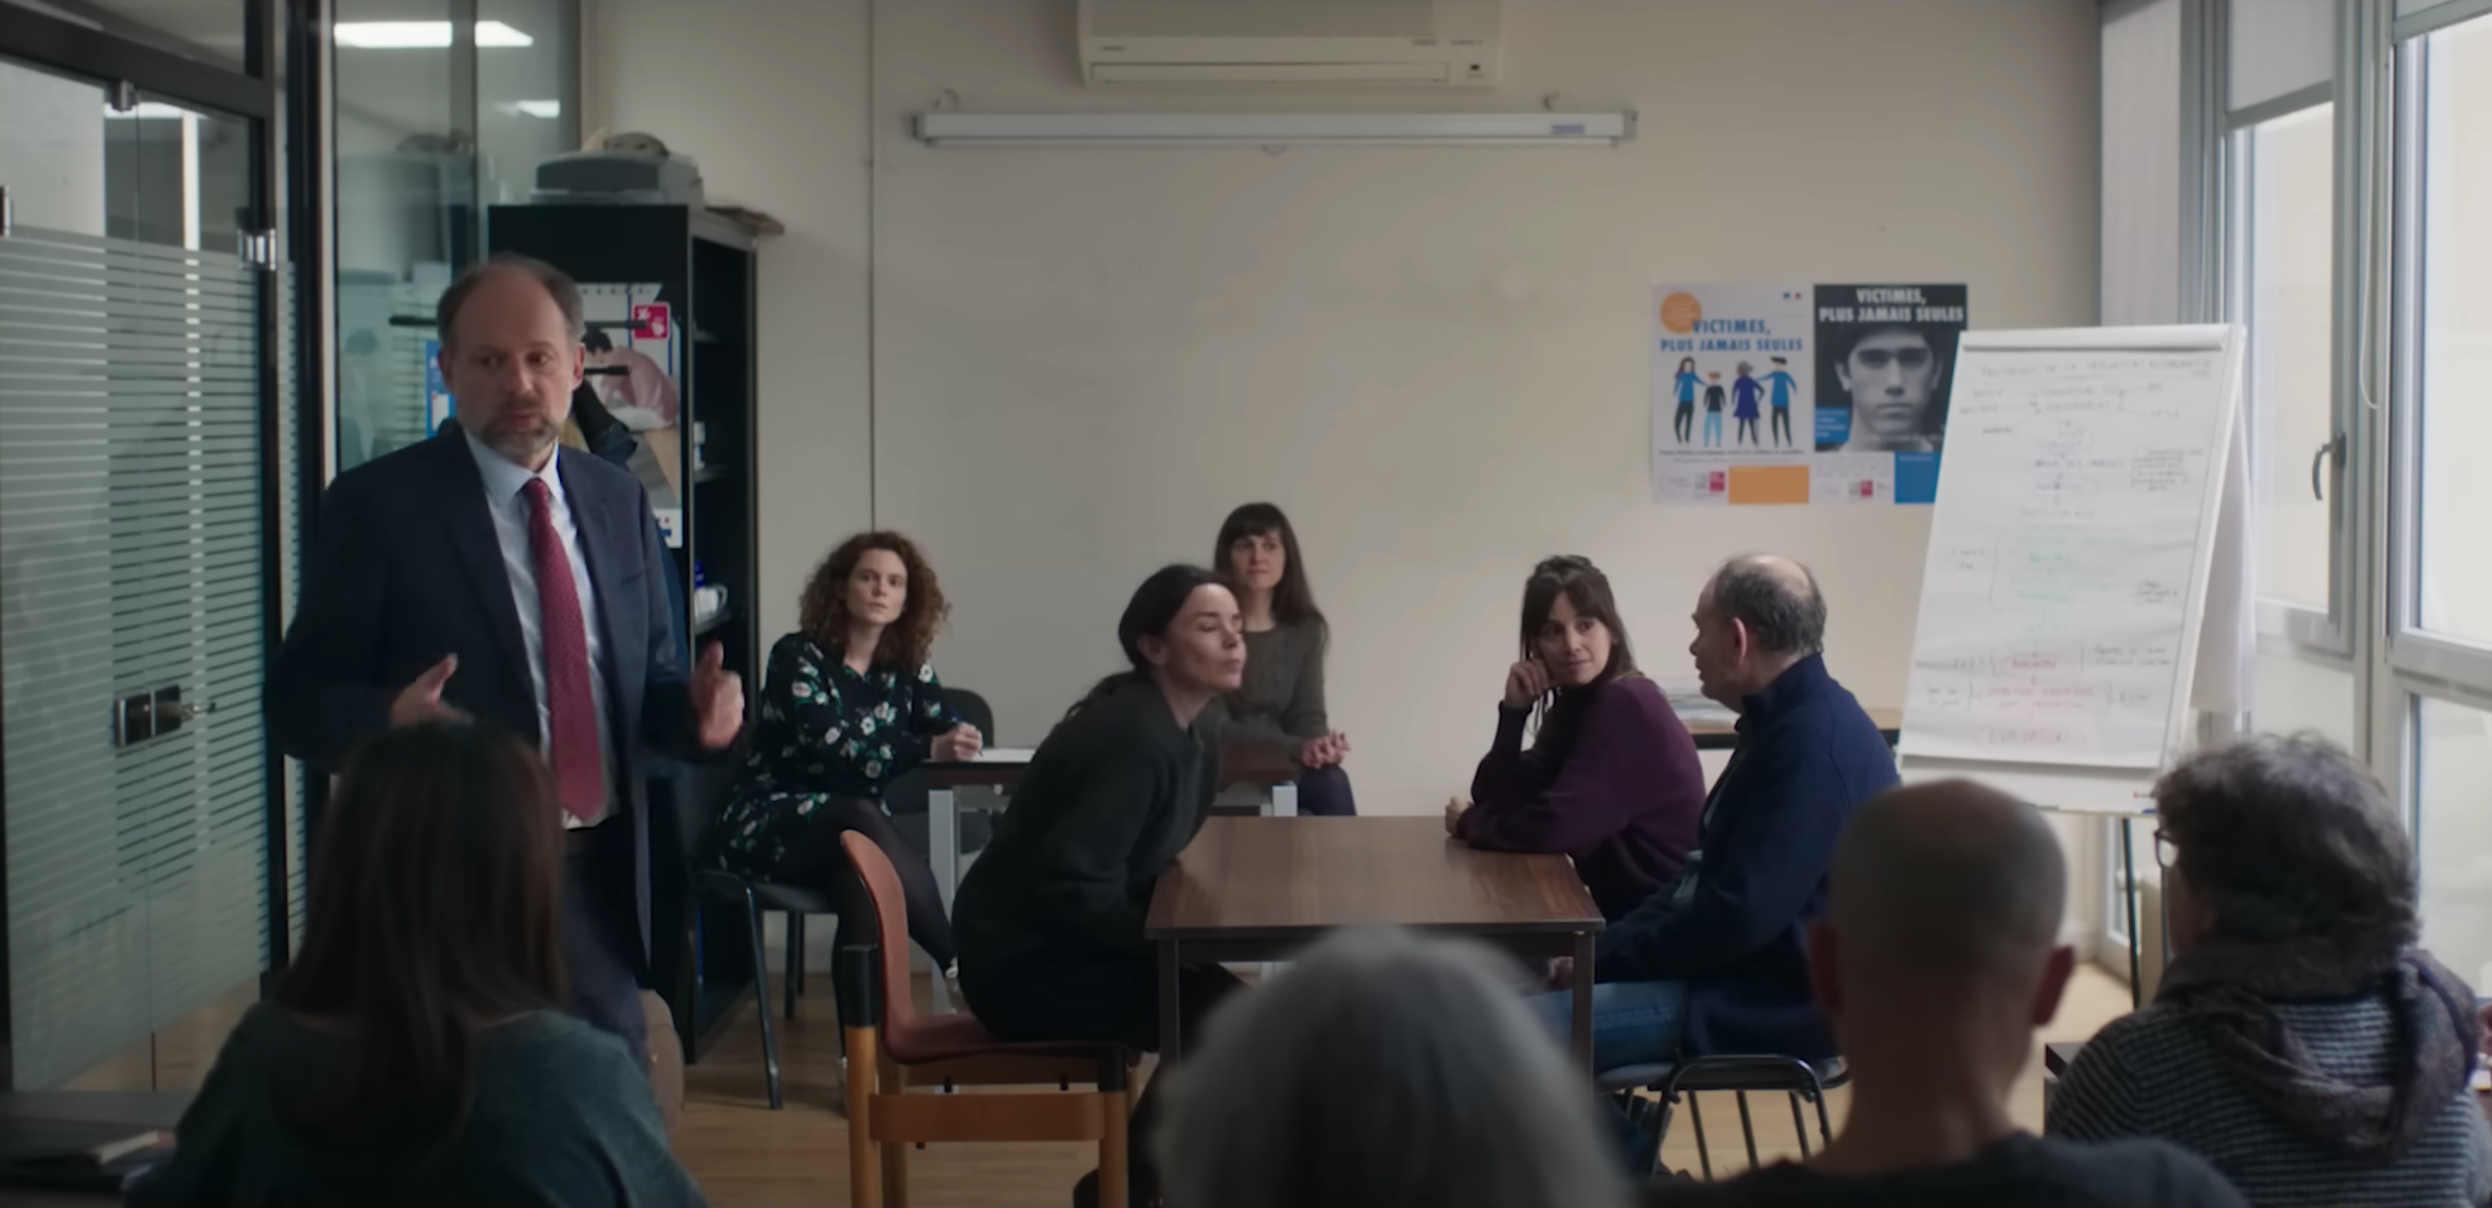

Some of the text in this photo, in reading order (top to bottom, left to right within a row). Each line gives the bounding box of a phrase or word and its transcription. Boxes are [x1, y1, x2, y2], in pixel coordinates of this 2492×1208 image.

[1856, 288, 1927, 305] VICTIMES,
[1819, 306, 1964, 322] PLUS JAMAIS SEULES
[1692, 319, 1772, 335] VICTIMES,
[1660, 338, 1803, 352] PLUS JAMAIS SEULES
